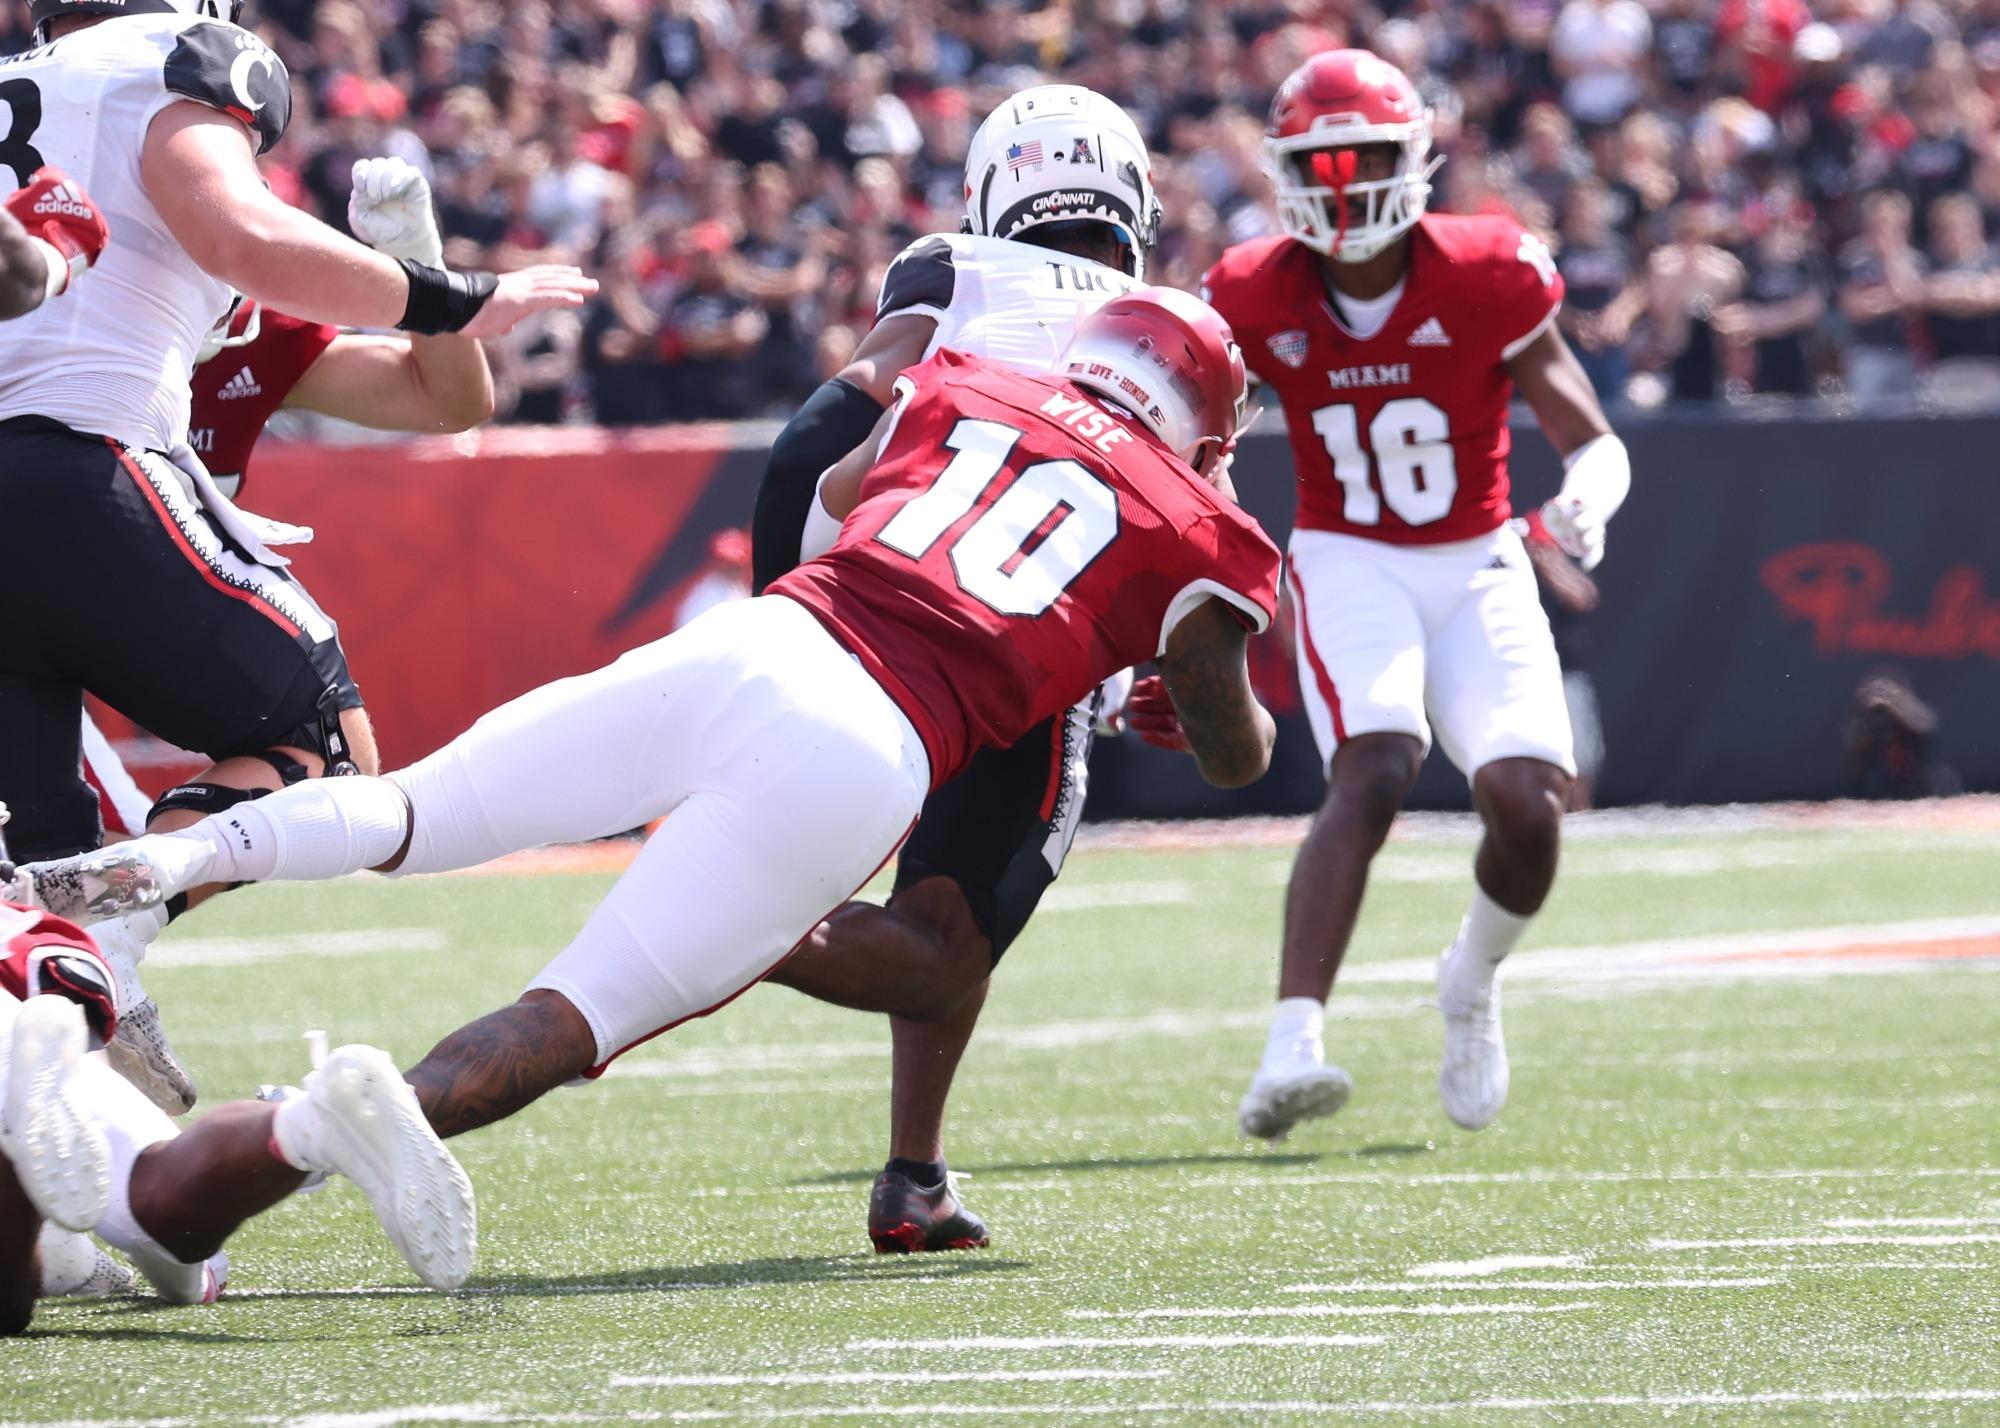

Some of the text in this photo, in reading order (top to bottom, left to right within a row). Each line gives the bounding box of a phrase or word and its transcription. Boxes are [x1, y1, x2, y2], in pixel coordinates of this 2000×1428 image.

[33, 199, 92, 219] adidas
[1032, 191, 1095, 212] CINCINNATI
[217, 384, 262, 400] adidas
[1088, 363, 1113, 379] LOVE
[1119, 377, 1150, 406] HONOR
[1327, 363, 1411, 389] MIAMI
[1040, 391, 1134, 453] WISE
[1312, 397, 1458, 526] 16
[871, 417, 1121, 619] 10
